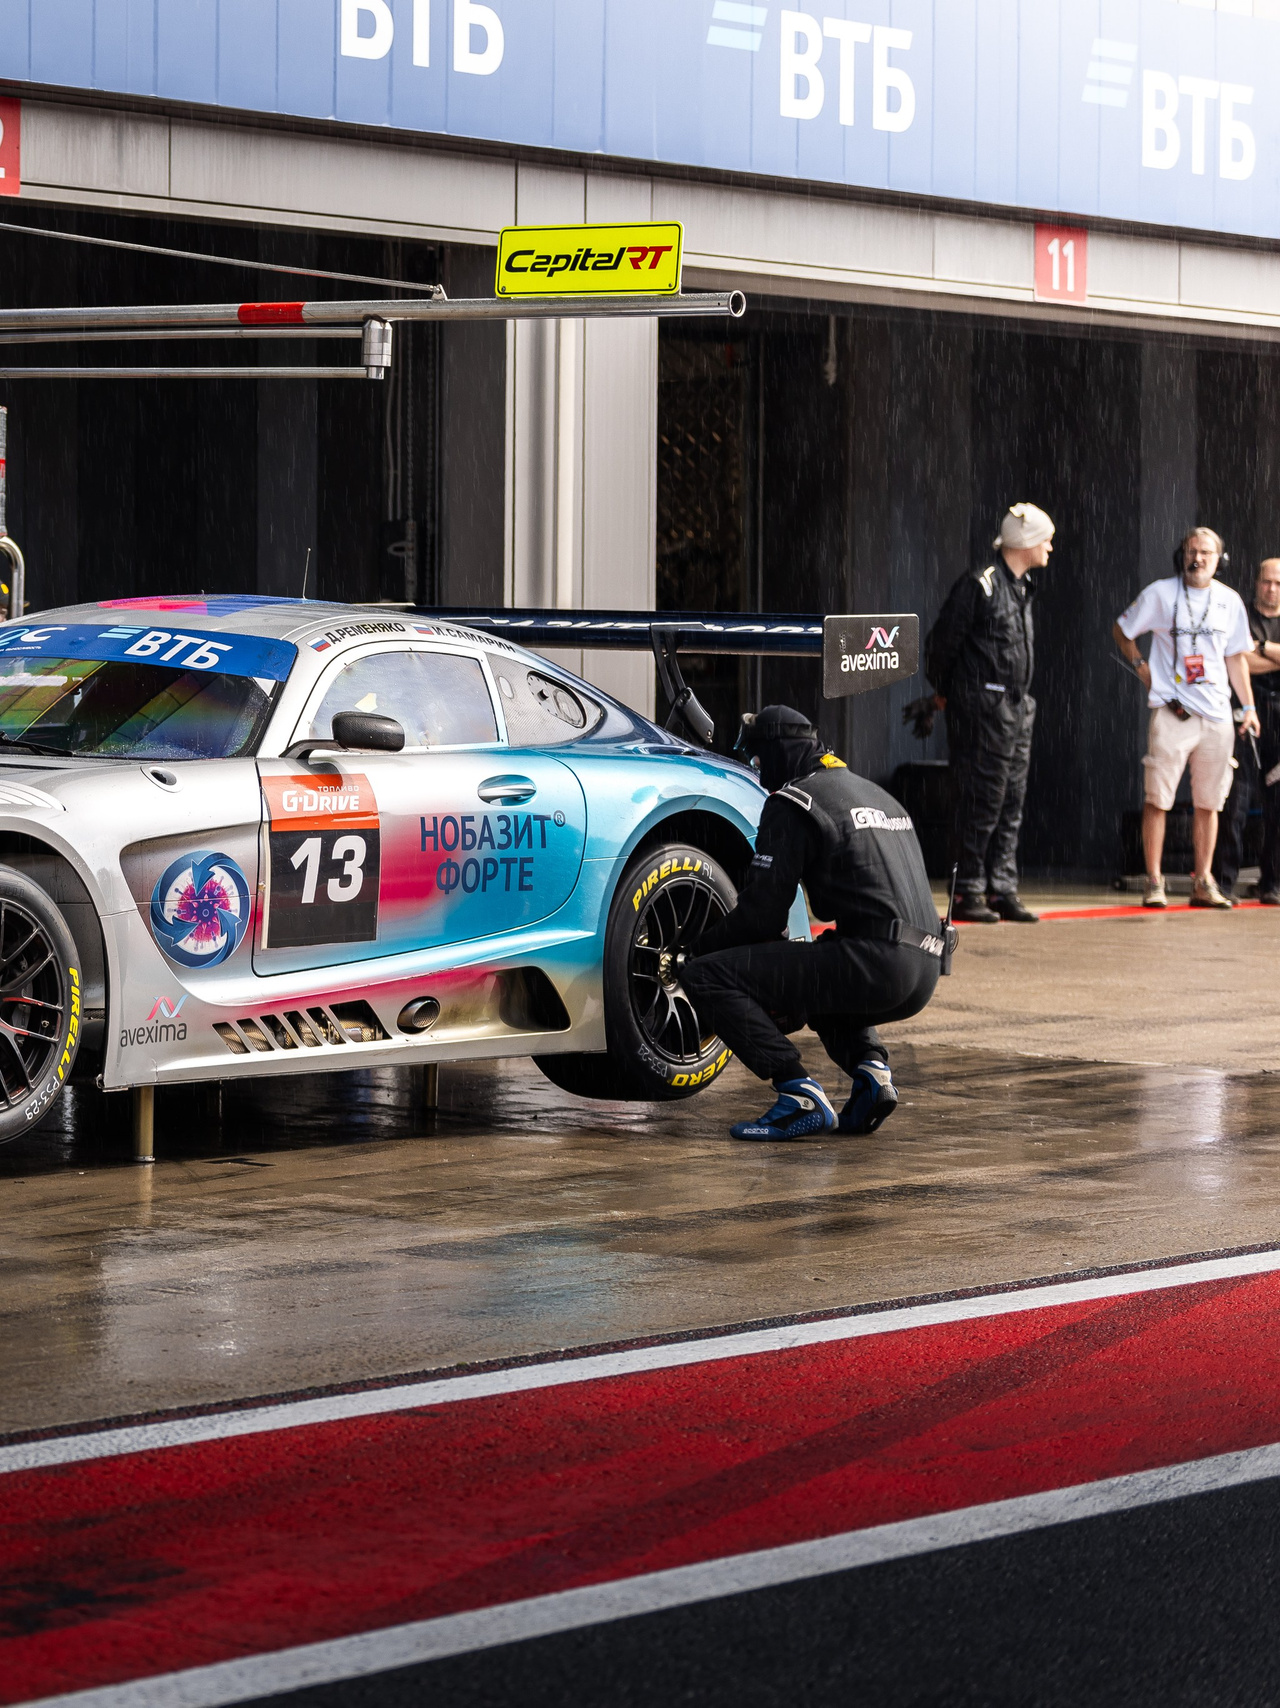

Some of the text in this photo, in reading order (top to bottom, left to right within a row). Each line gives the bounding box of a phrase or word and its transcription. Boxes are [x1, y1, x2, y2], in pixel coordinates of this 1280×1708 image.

[779, 9, 916, 132] ВТБ
[1141, 69, 1257, 181] ВТБ
[504, 245, 673, 278] CapitalRT
[1046, 238, 1075, 292] 11
[124, 631, 233, 670] ВТБ
[840, 647, 899, 673] avexima
[290, 834, 367, 904] 13
[436, 857, 534, 894] ФОРТЕ
[632, 856, 702, 912] PIRELLI
[58, 967, 80, 1080] PIRELLI
[120, 1019, 187, 1048] avexima
[671, 1049, 728, 1086] ZERO
